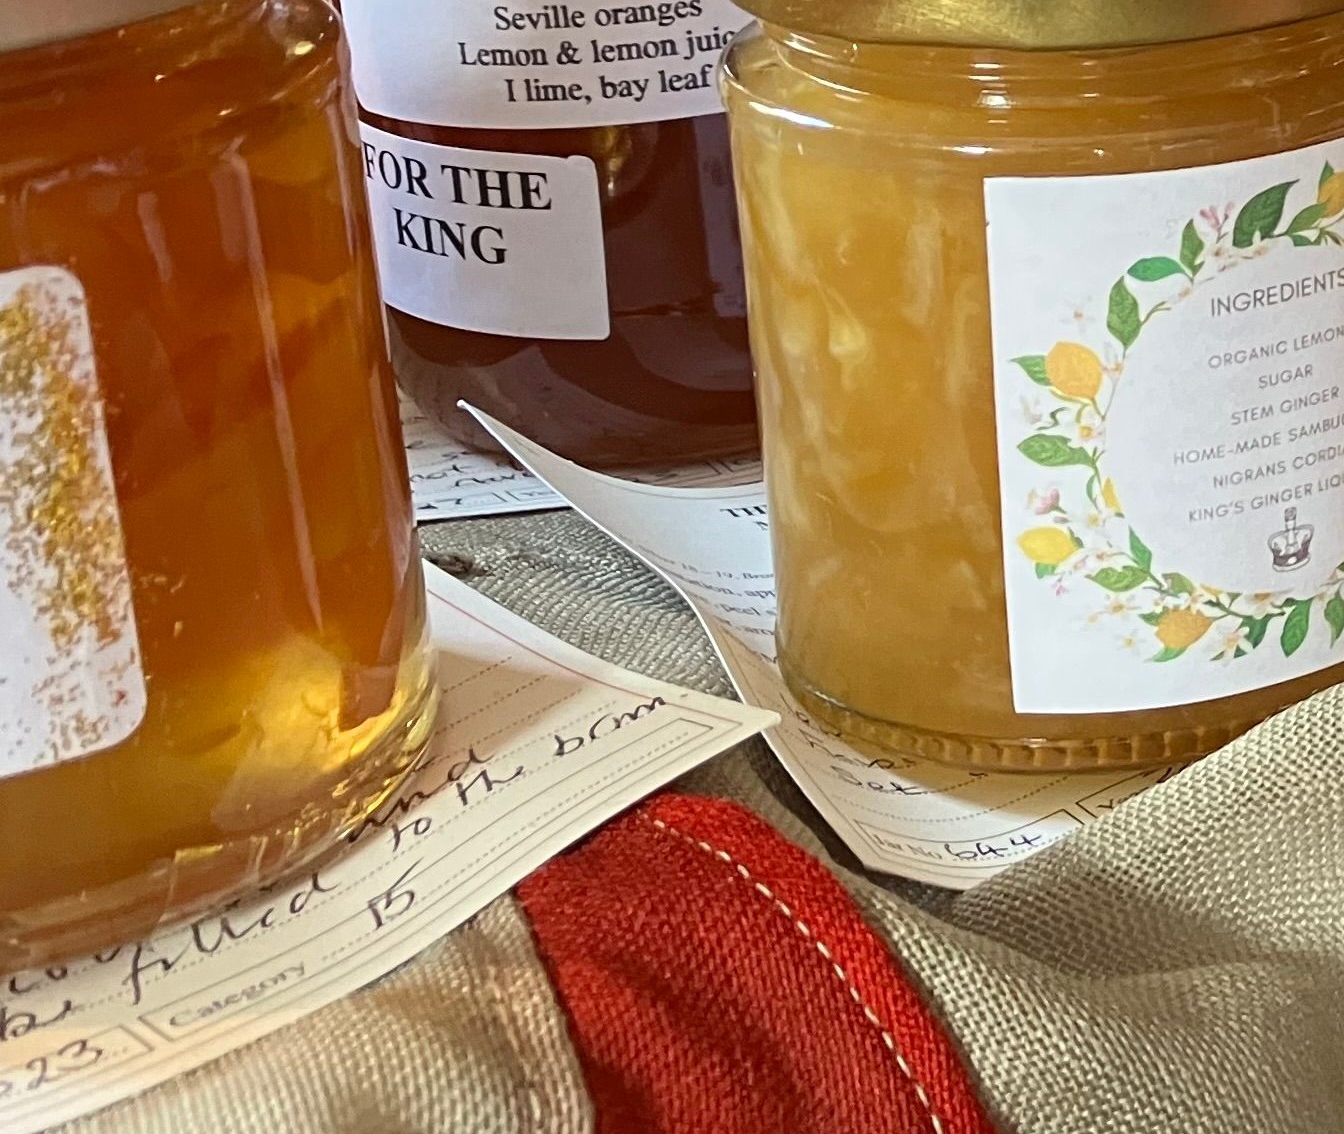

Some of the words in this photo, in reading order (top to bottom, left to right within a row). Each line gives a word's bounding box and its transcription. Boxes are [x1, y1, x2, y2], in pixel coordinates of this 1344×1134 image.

[494, 4, 586, 31] Seville
[457, 41, 547, 66] Lemon
[556, 40, 583, 64] &
[592, 34, 677, 63] lemon
[684, 26, 735, 60] juic
[525, 76, 592, 105] lime,
[600, 76, 649, 102] bay
[659, 64, 714, 93] leaf
[361, 141, 434, 200] FOR
[441, 164, 552, 210] THE
[393, 208, 508, 265] KING
[1207, 340, 1287, 370] ORGANIC
[1257, 364, 1314, 390] SUGAR
[1231, 404, 1274, 427] STEM
[1280, 385, 1340, 416] GINGER
[1172, 432, 1282, 466] HOME-MADE
[1213, 460, 1287, 489] NIGRANS
[1250, 482, 1313, 514] GINGER
[944, 834, 1042, 860] 644
[170, 962, 306, 1027] Category
